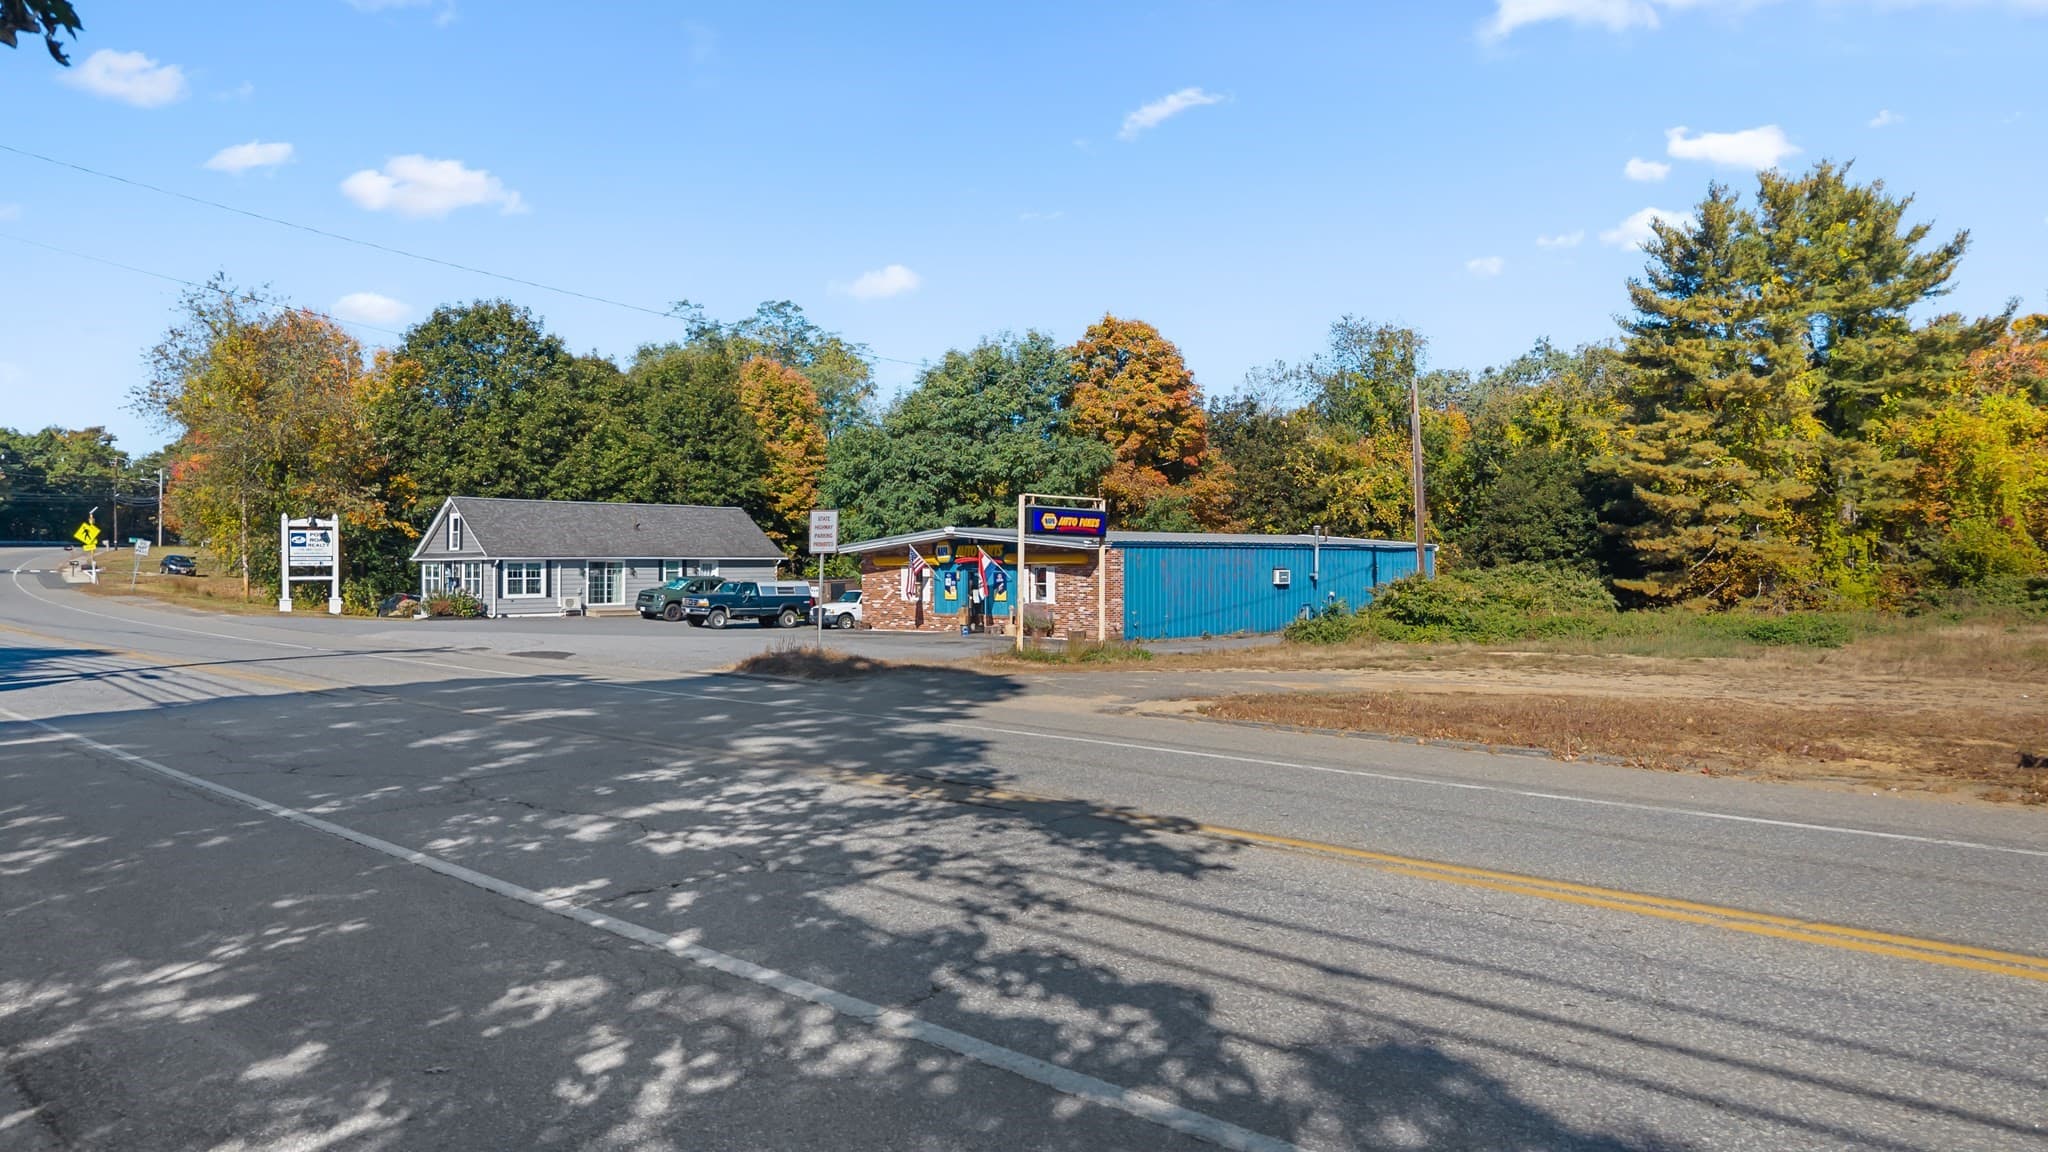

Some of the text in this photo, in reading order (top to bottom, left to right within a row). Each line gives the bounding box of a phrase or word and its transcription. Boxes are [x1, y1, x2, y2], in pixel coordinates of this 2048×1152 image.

[1058, 516, 1078, 527] AUTO
[1079, 517, 1101, 528] PARTS
[955, 544, 977, 557] AUTO
